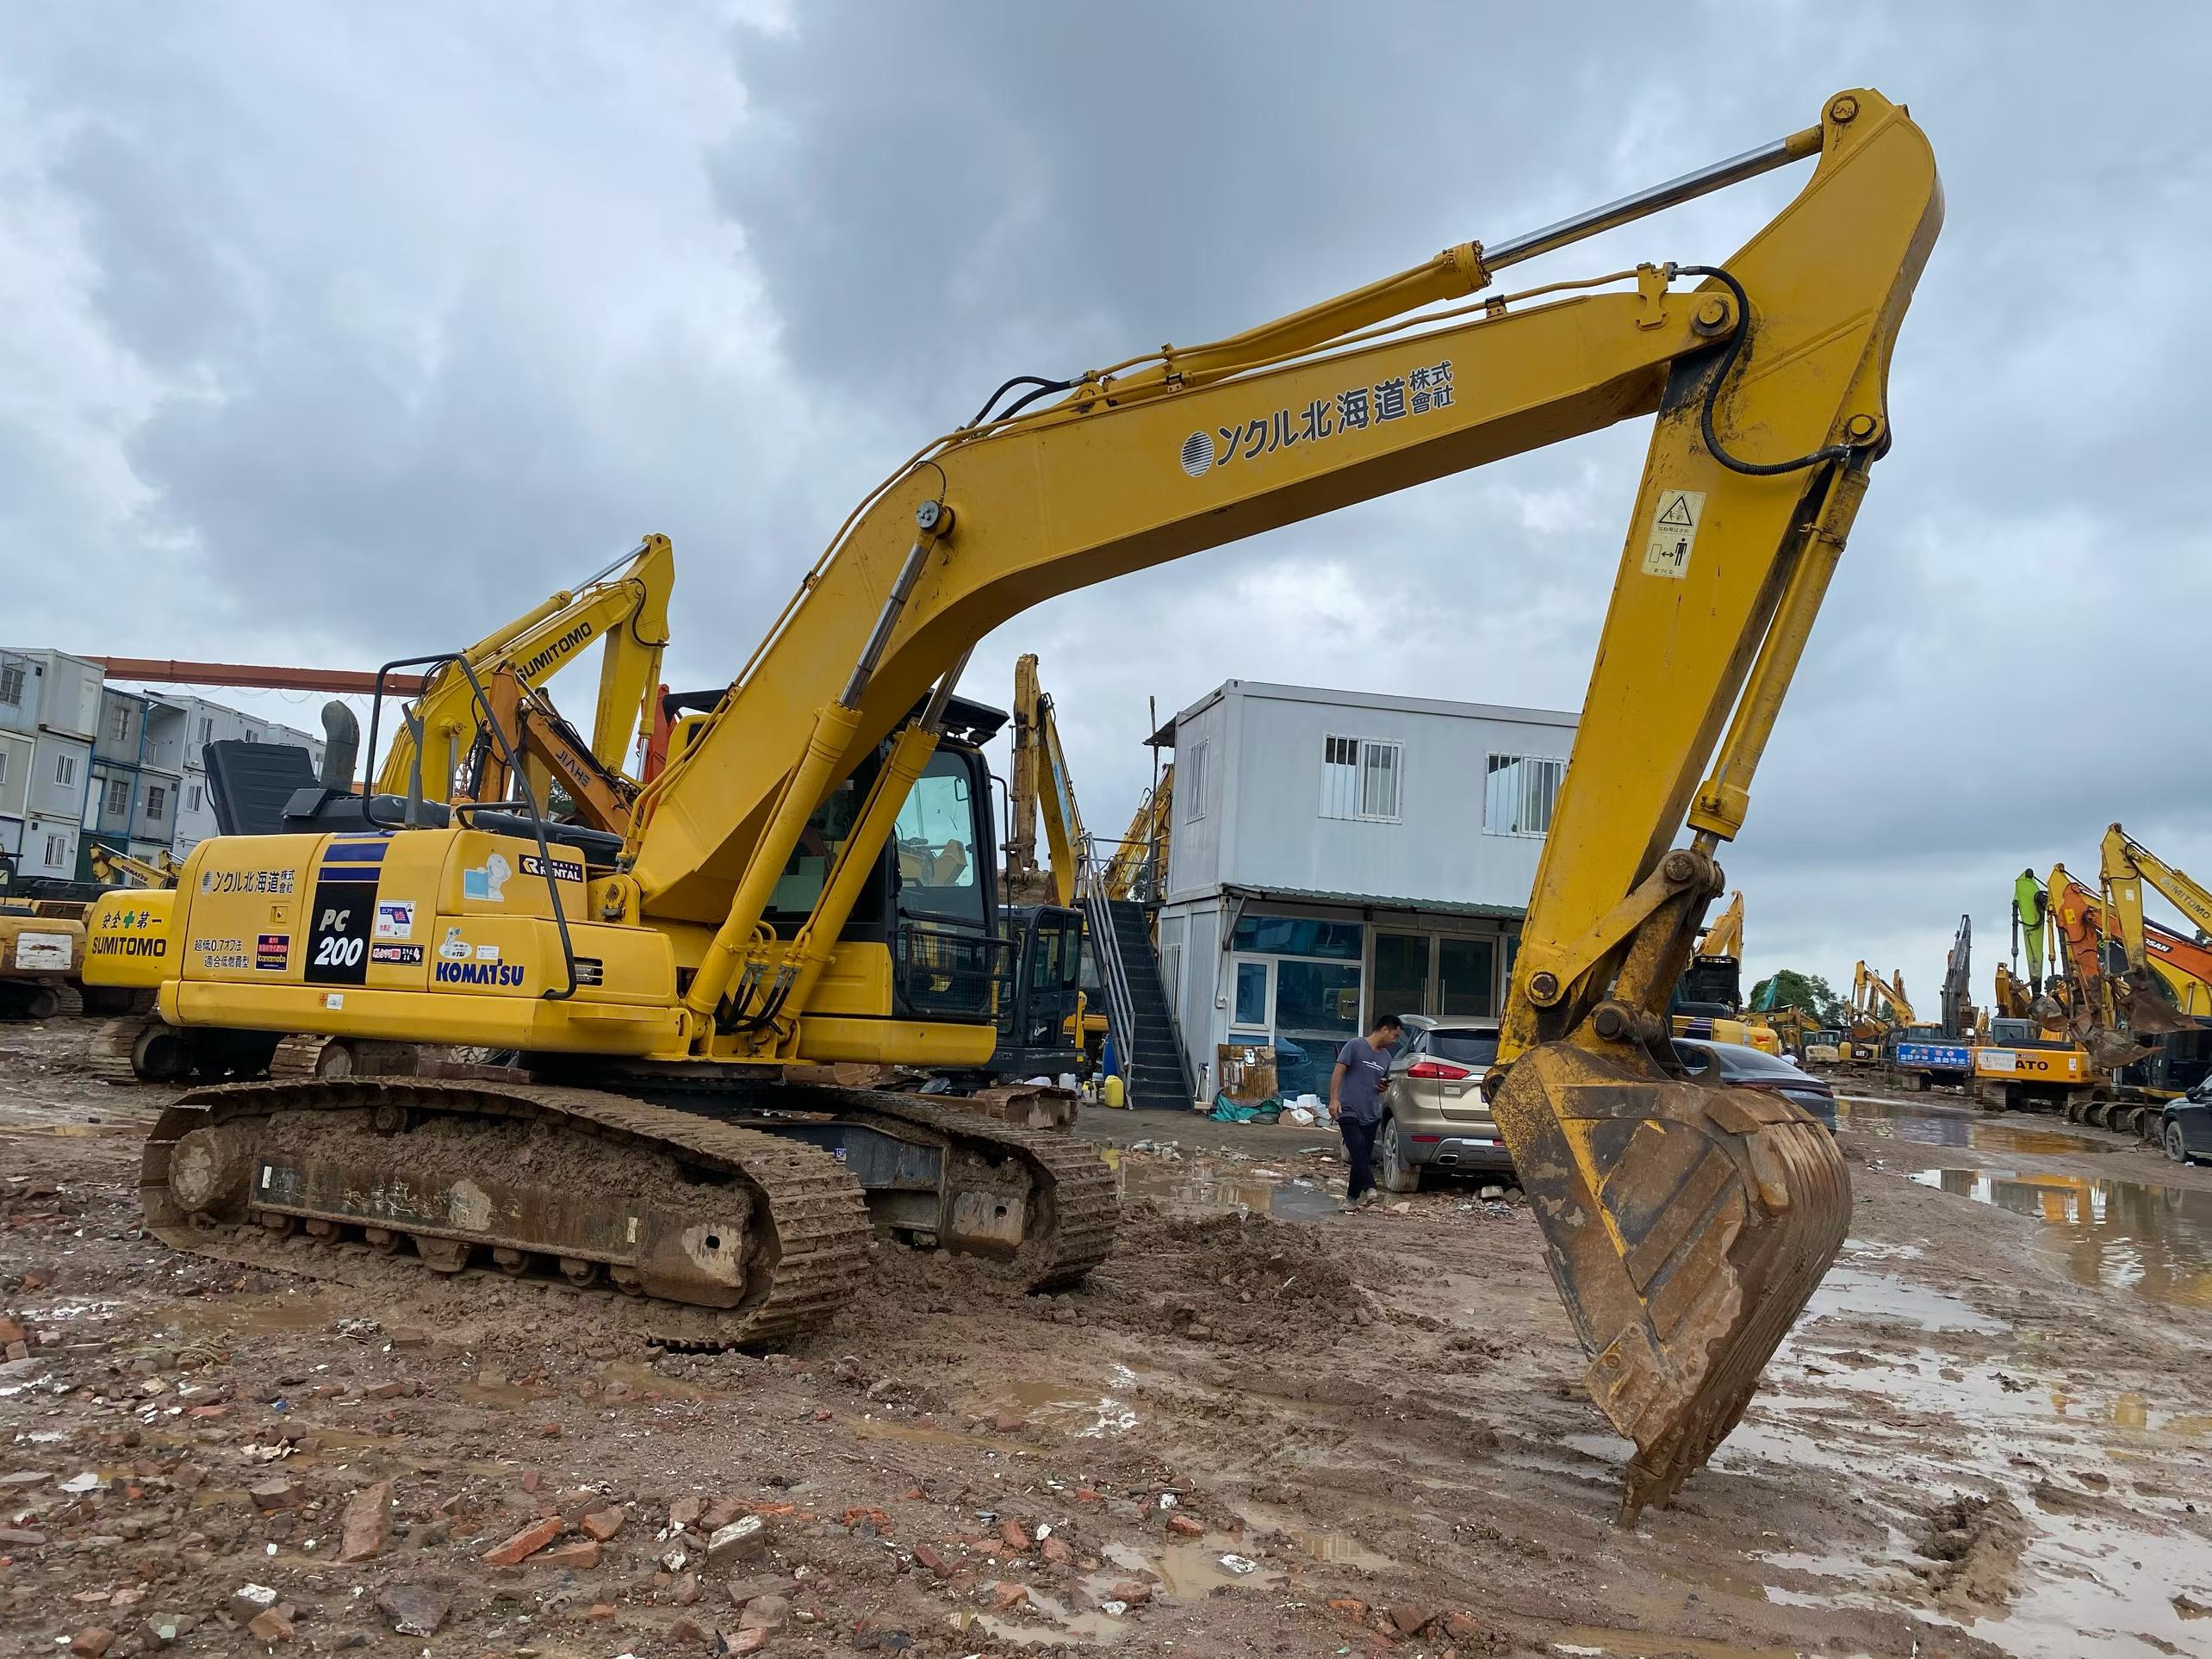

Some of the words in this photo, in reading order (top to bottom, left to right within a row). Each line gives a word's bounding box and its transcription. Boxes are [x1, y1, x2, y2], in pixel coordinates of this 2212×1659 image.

[516, 622, 593, 683] SUMITOMO
[121, 865, 149, 882] KOMATSU
[540, 866, 581, 881] RNTAL
[319, 909, 351, 932] PC
[91, 936, 167, 957] SUMITOMO
[314, 936, 363, 966] 200
[435, 958, 525, 987] KOMATSU
[2015, 1059, 2049, 1071] ATO
